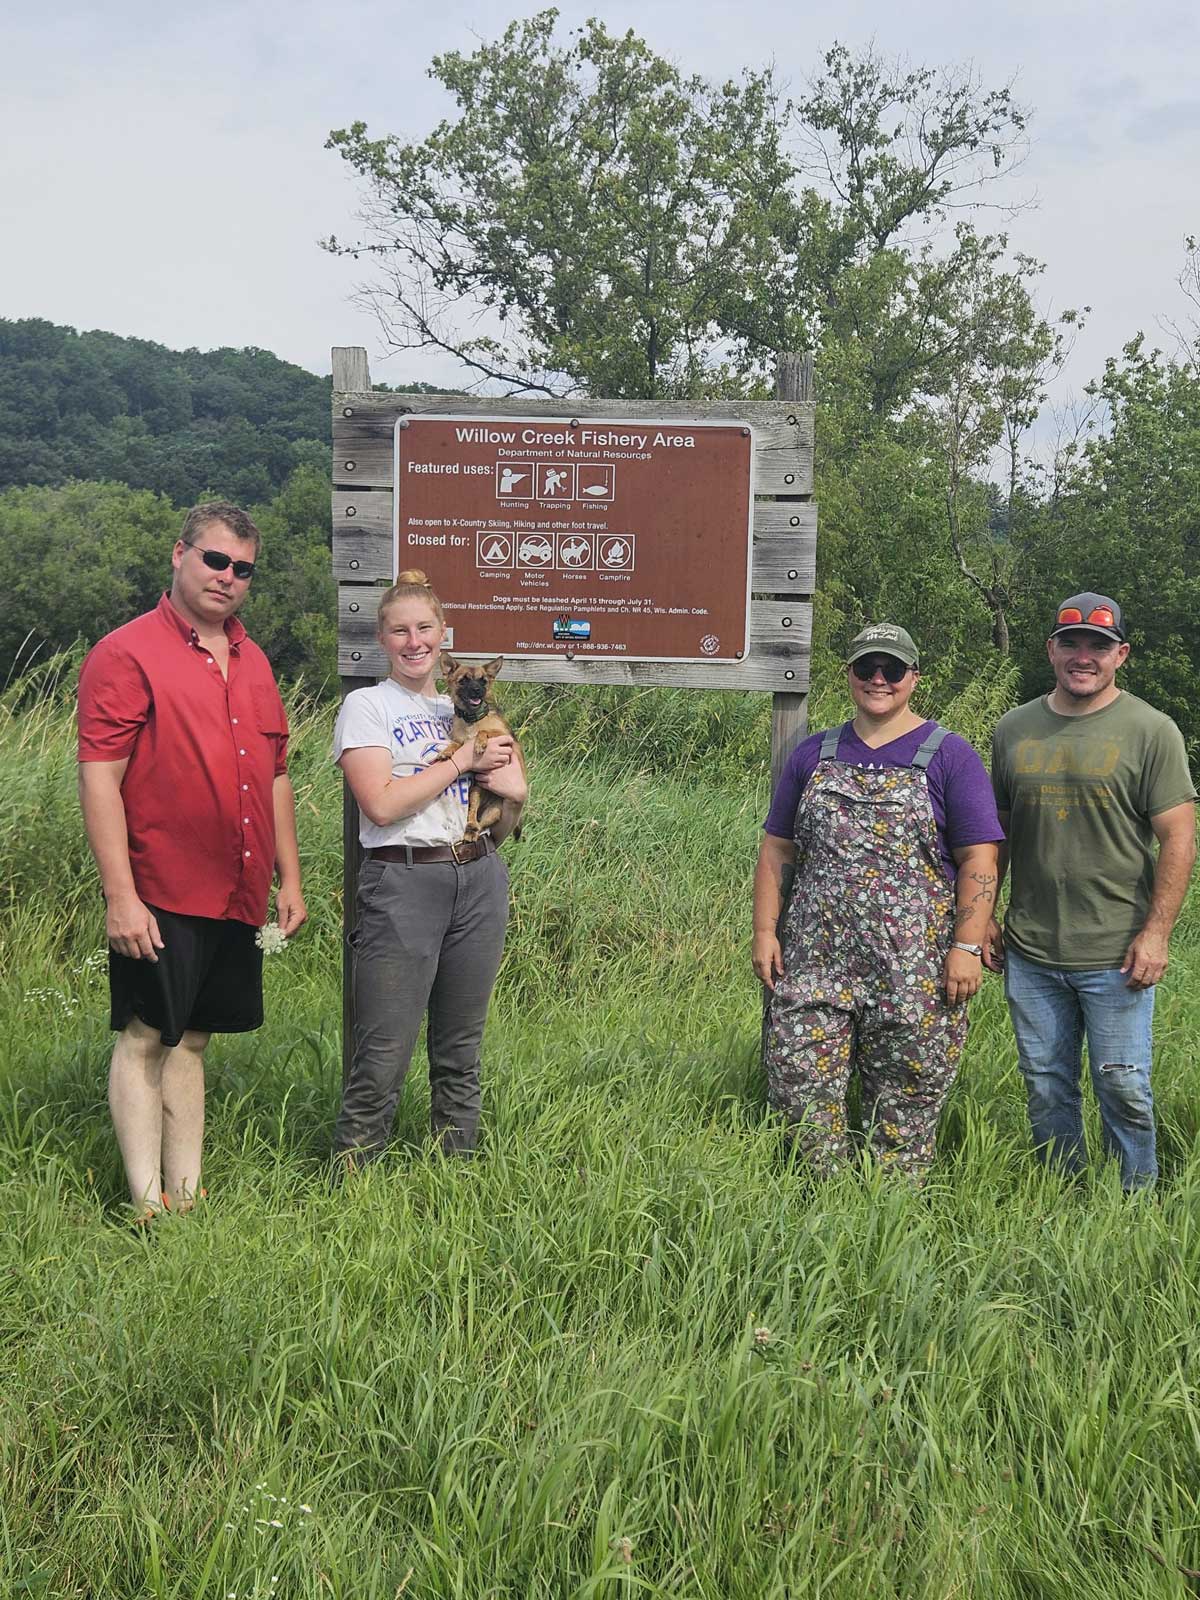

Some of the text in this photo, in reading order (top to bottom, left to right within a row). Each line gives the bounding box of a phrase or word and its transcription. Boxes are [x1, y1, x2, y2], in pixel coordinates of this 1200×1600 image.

[456, 428, 695, 450] Willow Creek Fishery Area
[498, 448, 552, 458] Department
[567, 450, 600, 458] Natural
[603, 450, 652, 460] Resources
[408, 462, 494, 475] Featured uses:
[500, 502, 529, 510] Hunting
[539, 502, 571, 510] Trapping
[582, 503, 608, 511] Fishing
[408, 518, 424, 526] Also
[424, 520, 442, 528] open
[452, 519, 486, 528] X-Country
[488, 520, 512, 528] Skiing,
[514, 520, 536, 529] Hiking
[586, 522, 608, 530] travel.
[408, 534, 470, 546] Closed for:
[480, 572, 510, 580] Camping
[599, 574, 631, 582] Campfire
[493, 596, 511, 604] Dogs
[570, 598, 588, 606] April
[598, 598, 626, 606] through
[628, 598, 642, 606] July
[506, 604, 525, 612] Apply.
[540, 604, 572, 612] Regulation
[573, 605, 606, 614] Pamphlets
